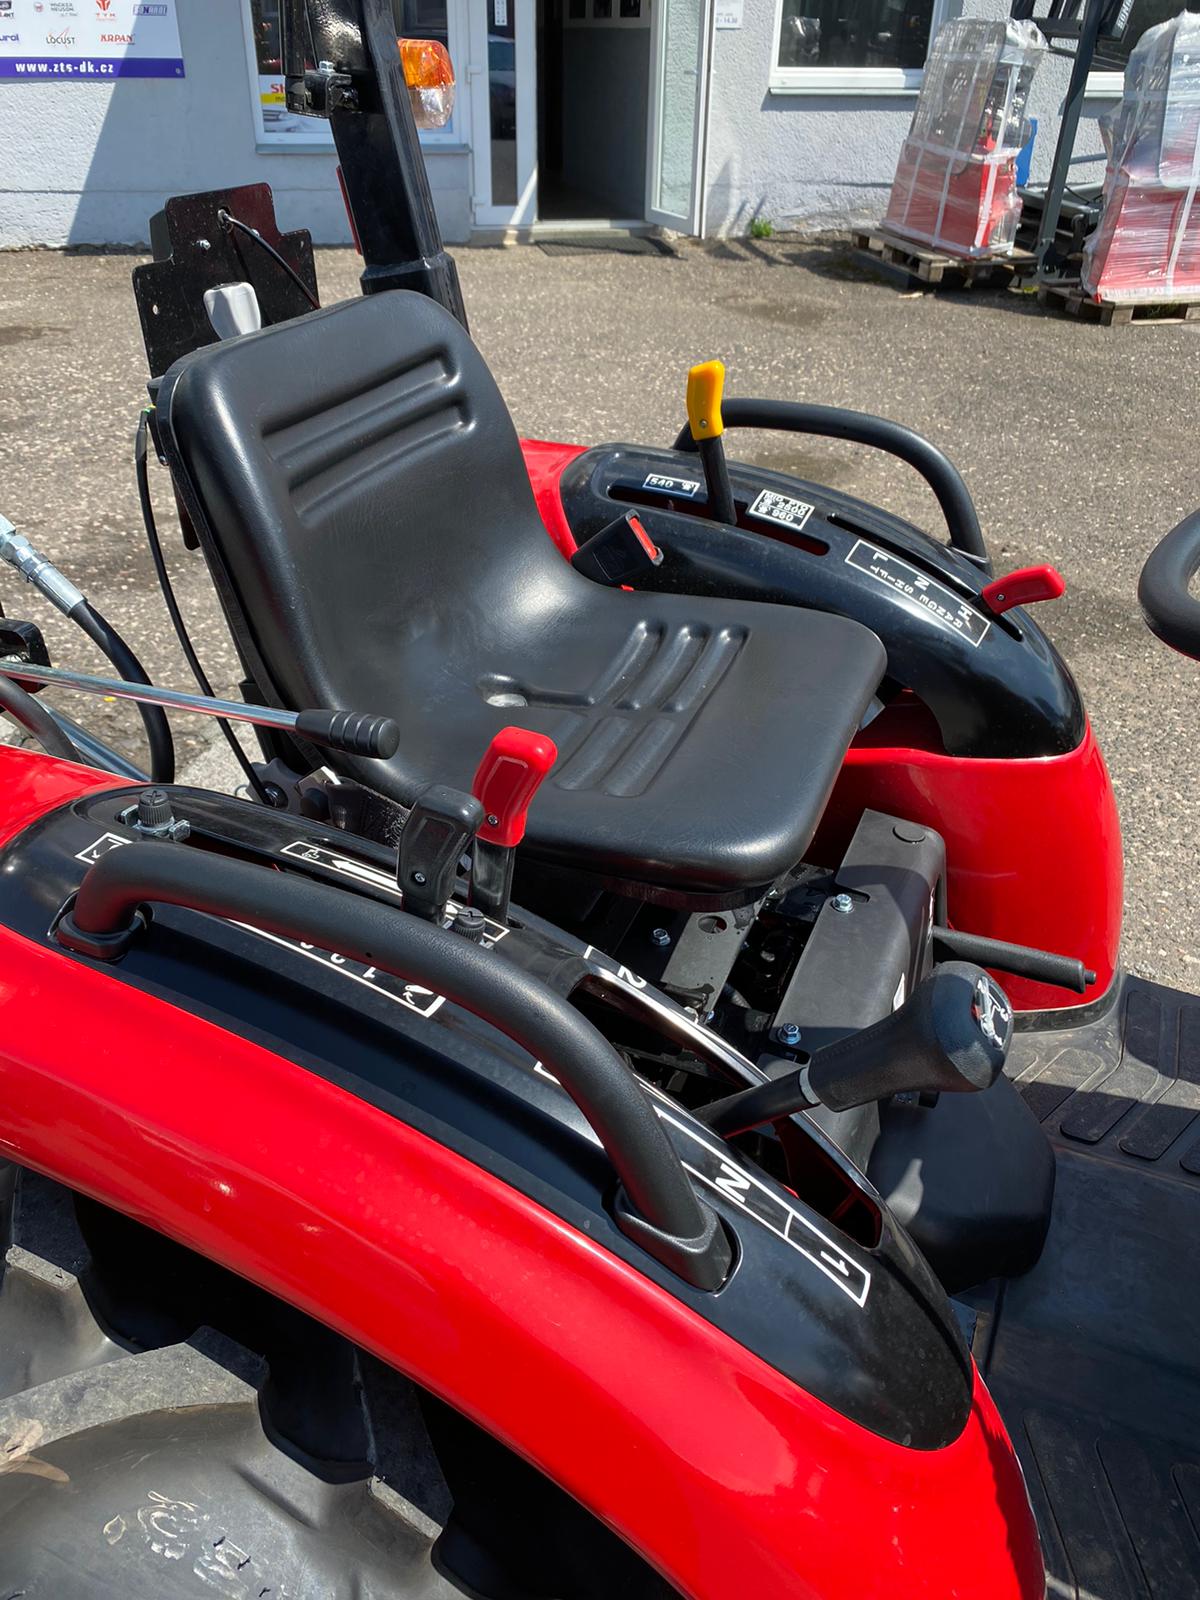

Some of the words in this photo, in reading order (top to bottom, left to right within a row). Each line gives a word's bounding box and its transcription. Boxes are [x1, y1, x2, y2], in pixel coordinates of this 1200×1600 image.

[100, 34, 133, 42] KRPAN
[15, 60, 114, 73] www.zts-dk.cz
[649, 477, 674, 488] 540
[872, 552, 889, 562] L
[870, 565, 914, 594] SHIFT
[913, 576, 931, 591] N
[918, 594, 964, 629] RANGE
[957, 605, 973, 621] H
[617, 965, 647, 989] 2
[715, 1162, 751, 1204] N
[820, 1250, 850, 1277] 1
